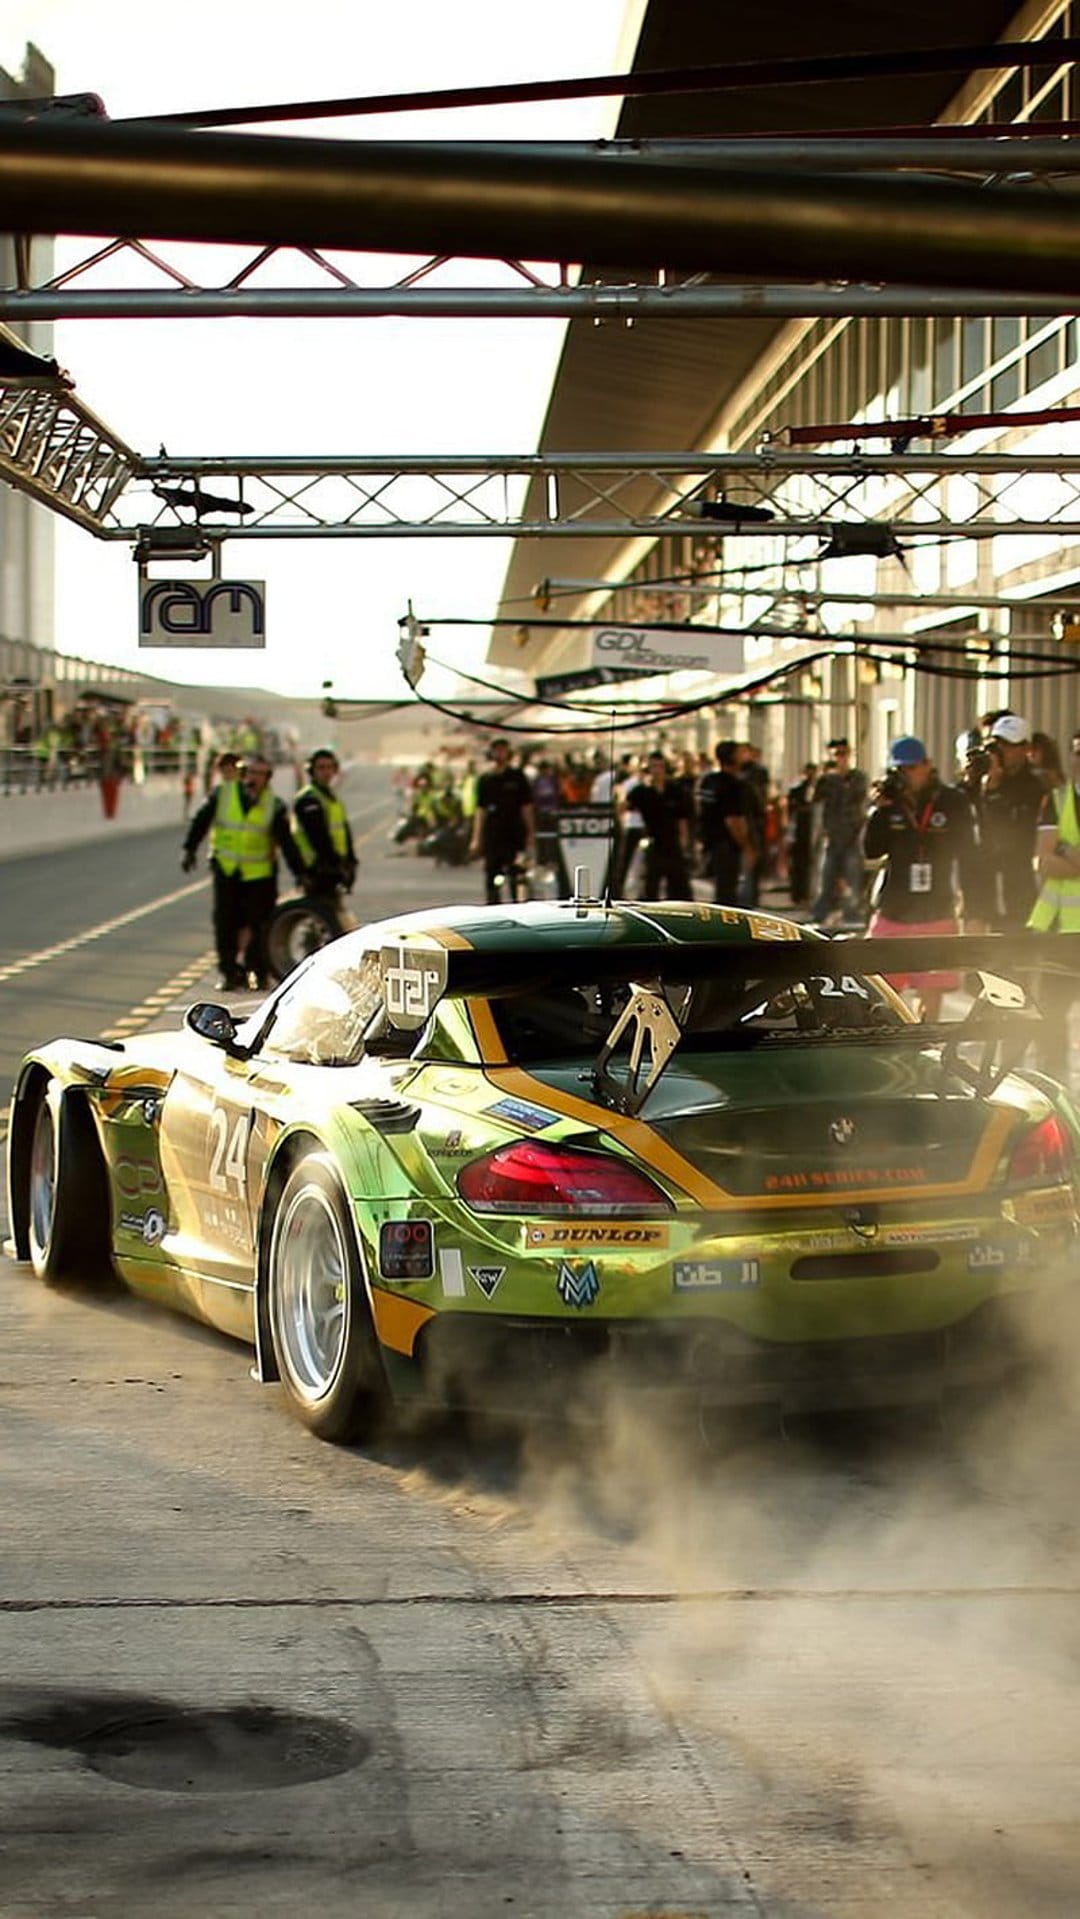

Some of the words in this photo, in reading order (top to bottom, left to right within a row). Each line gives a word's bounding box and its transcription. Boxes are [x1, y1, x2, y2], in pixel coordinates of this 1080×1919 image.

[142, 582, 264, 634] ram
[595, 631, 651, 650] GDL
[559, 818, 615, 834] STOP
[811, 975, 869, 999] 24
[208, 1108, 249, 1200] 24
[384, 1223, 429, 1245] 100
[550, 1228, 661, 1243] DUNLOP
